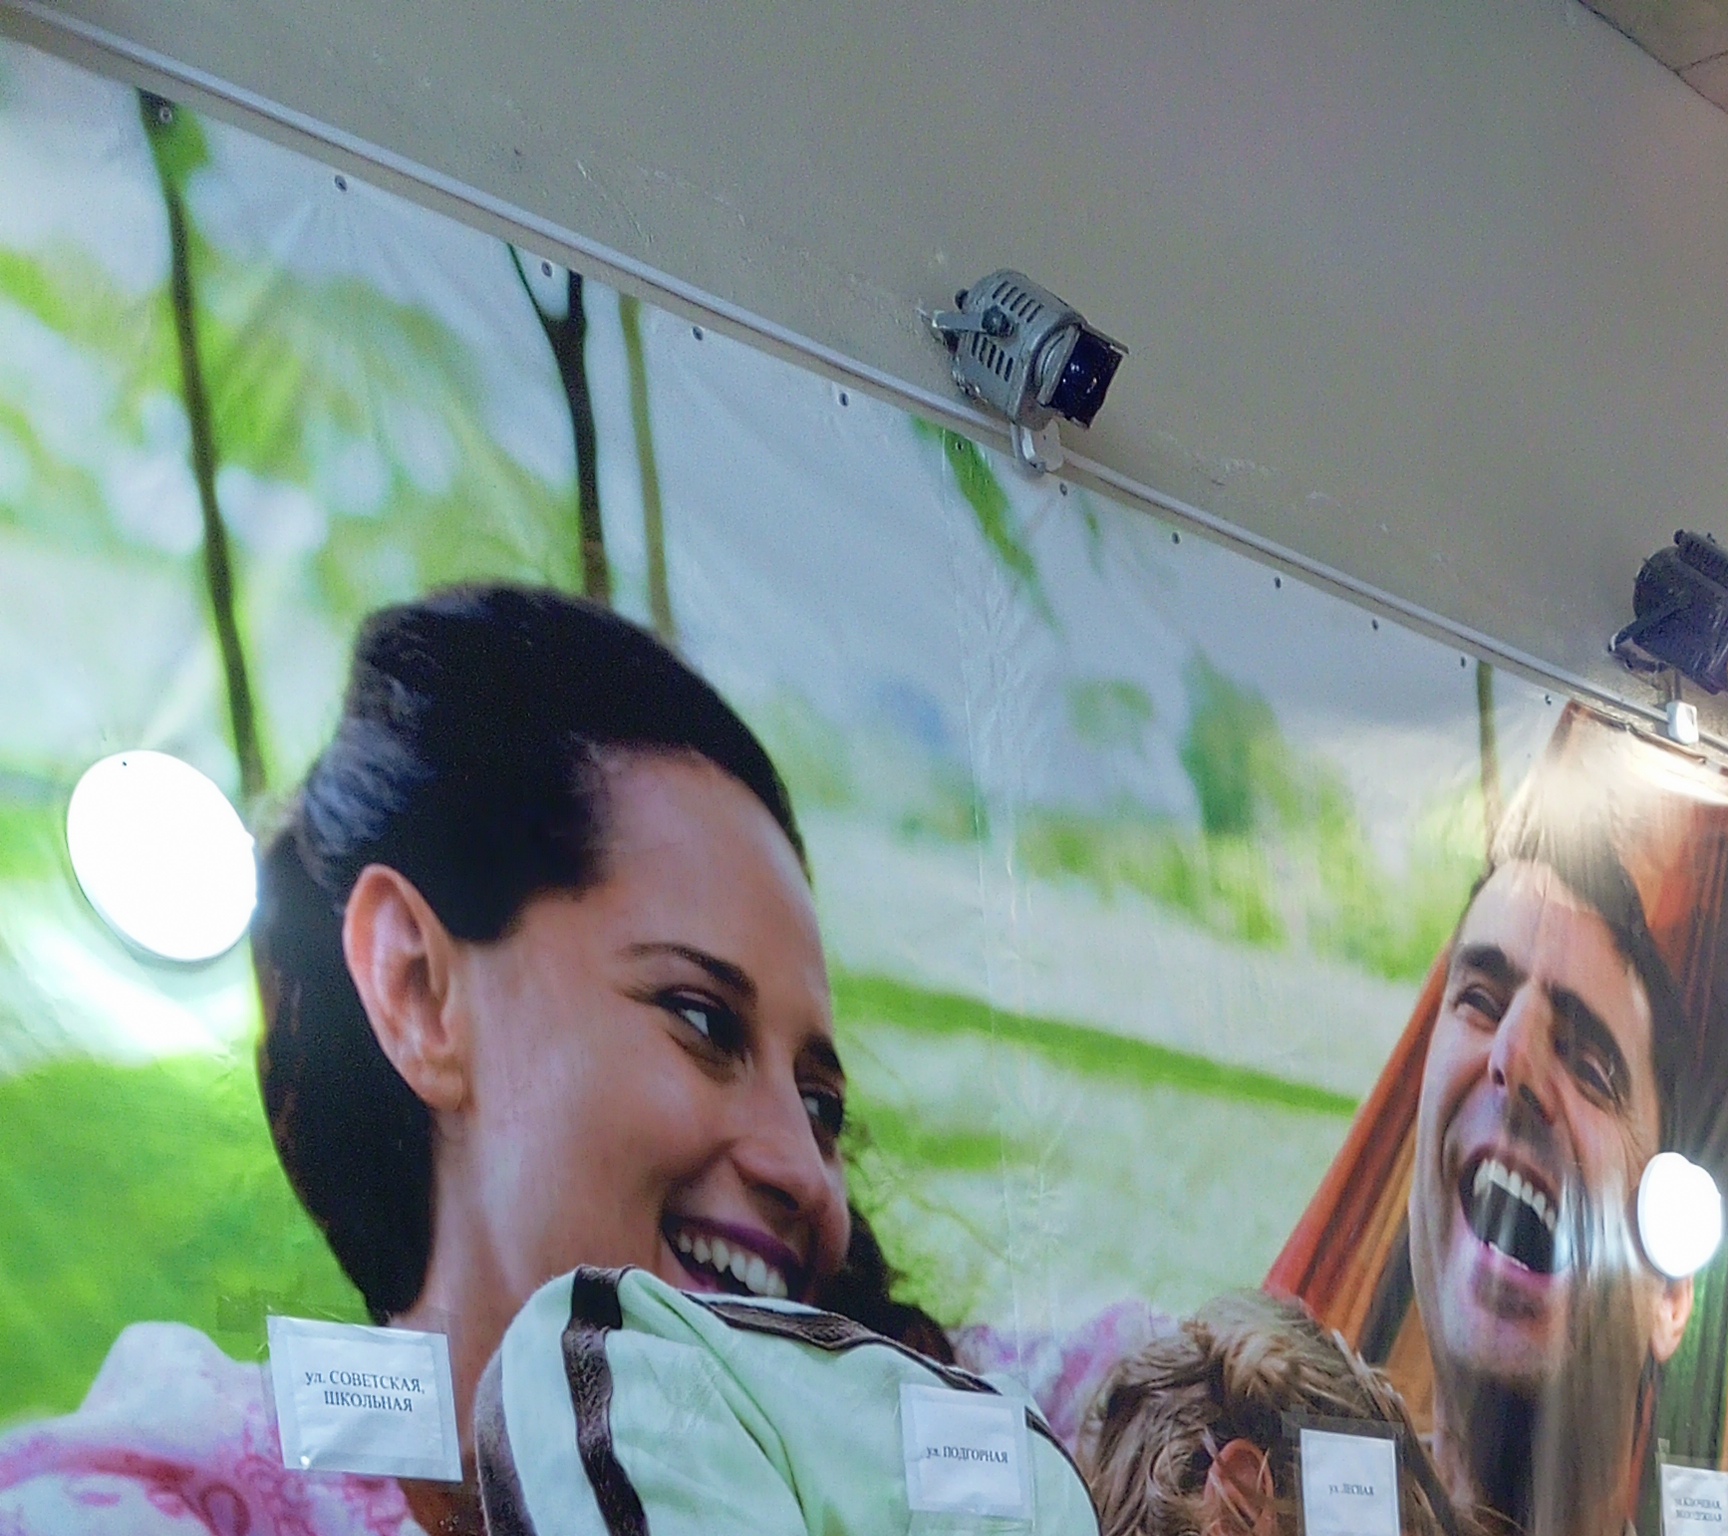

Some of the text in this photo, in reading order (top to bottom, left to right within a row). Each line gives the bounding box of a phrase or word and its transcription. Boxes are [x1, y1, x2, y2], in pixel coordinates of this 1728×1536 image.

[305, 1370, 425, 1394] ул. СОВЕТСКАЯ,
[324, 1390, 413, 1412] ШКОЛЬНАЯ
[943, 1445, 1008, 1463] ПОДГОРНАЯ
